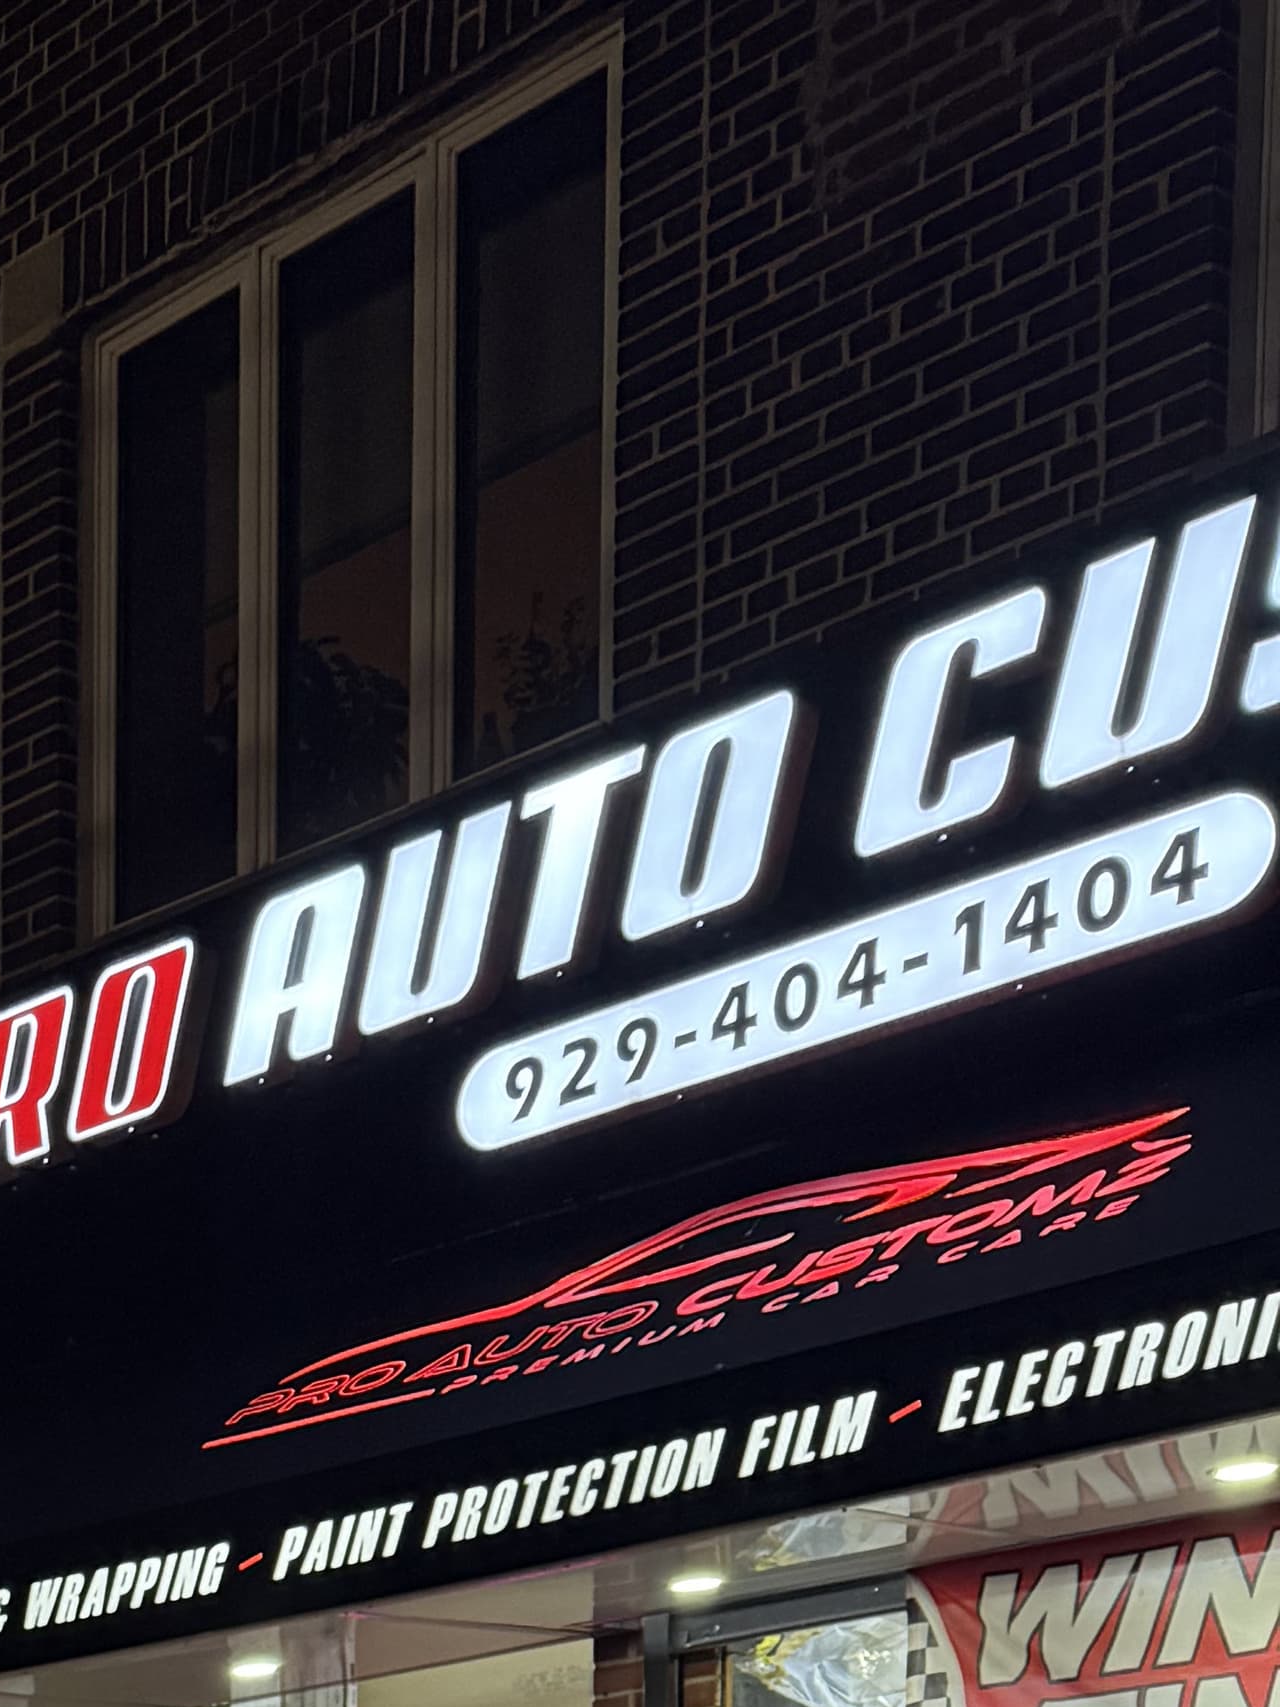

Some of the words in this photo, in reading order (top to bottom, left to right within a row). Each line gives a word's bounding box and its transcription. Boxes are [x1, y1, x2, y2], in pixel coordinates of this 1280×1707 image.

[224, 689, 796, 1087] AUTO
[504, 826, 1209, 1122] 929-404-1404
[224, 1359, 407, 1426] PRO
[403, 1300, 659, 1383] AUTO
[675, 1134, 1193, 1316] CUSTOMZ
[440, 1311, 726, 1395] PREMIUM
[760, 1263, 901, 1314] CAR
[937, 1194, 1140, 1265] CARE
[22, 1540, 232, 1632] WRAPPING
[272, 1500, 415, 1581] PAINT
[421, 1427, 728, 1551] PROTECTION
[737, 1389, 879, 1479] FILM
[937, 1289, 1280, 1433] ELECTRONI
